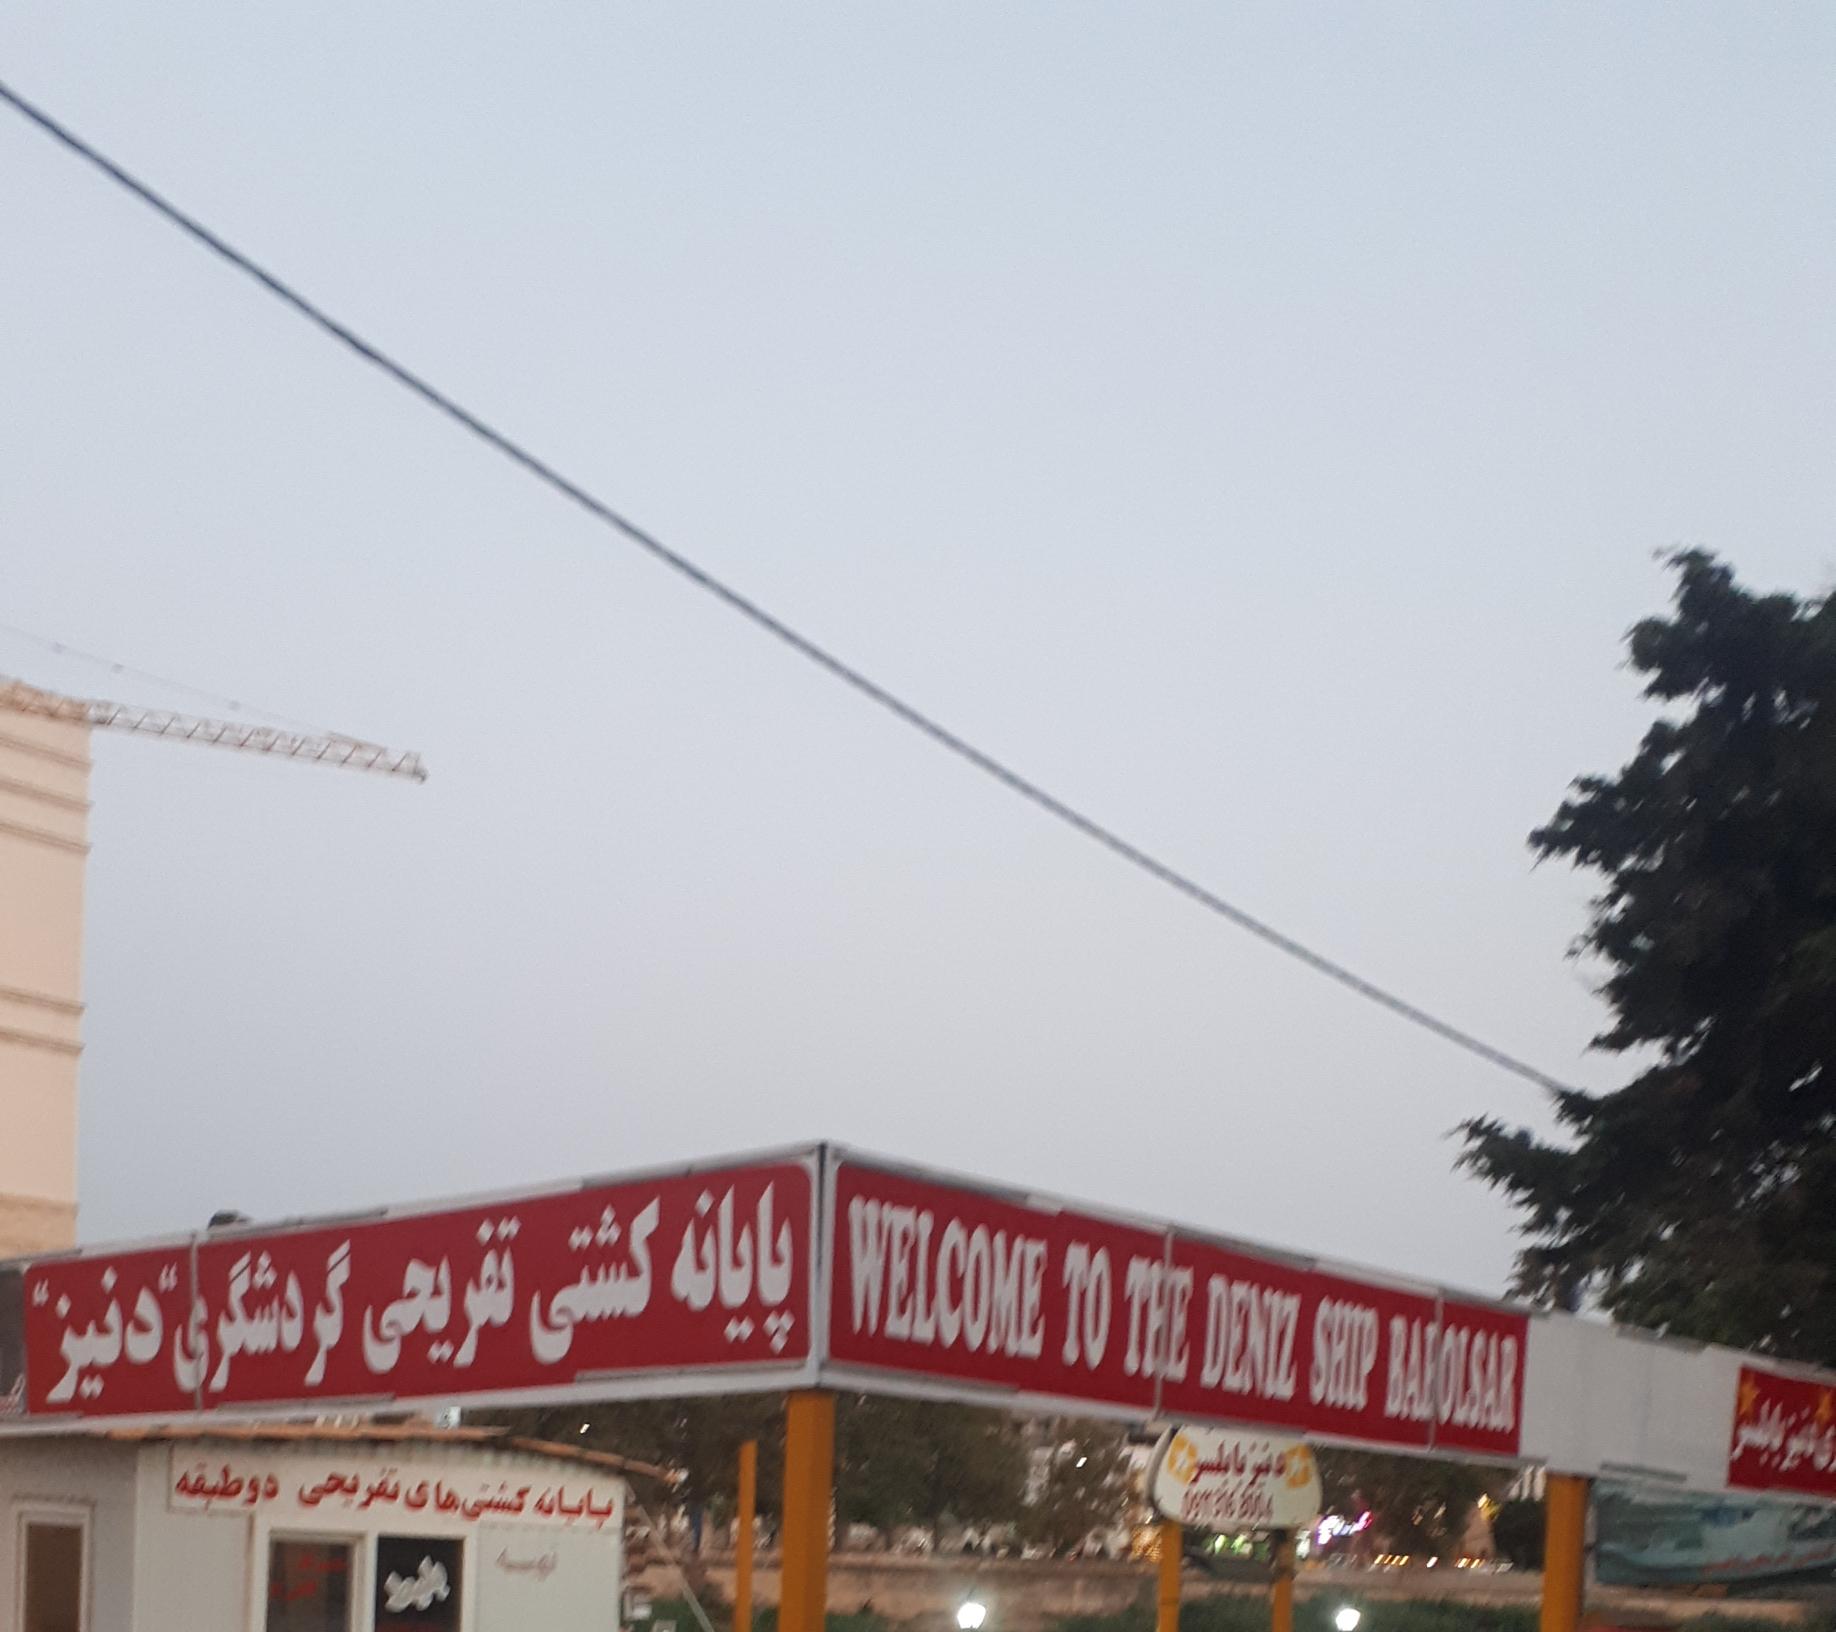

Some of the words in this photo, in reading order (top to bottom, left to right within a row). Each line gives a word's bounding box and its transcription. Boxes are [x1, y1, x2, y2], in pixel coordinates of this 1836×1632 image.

[173, 1239, 352, 1393] گردشگری
[363, 1216, 522, 1368] تفریحی
[529, 1196, 660, 1364] کشتی
[671, 1180, 796, 1355] پایانه
[848, 1194, 1048, 1360] WELCOME
[1063, 1240, 1112, 1371] TO
[1124, 1254, 1194, 1384] THE
[1201, 1273, 1302, 1402] DENIZ
[1309, 1295, 1379, 1412] SHIP
[298, 1467, 399, 1510] تفریحی
